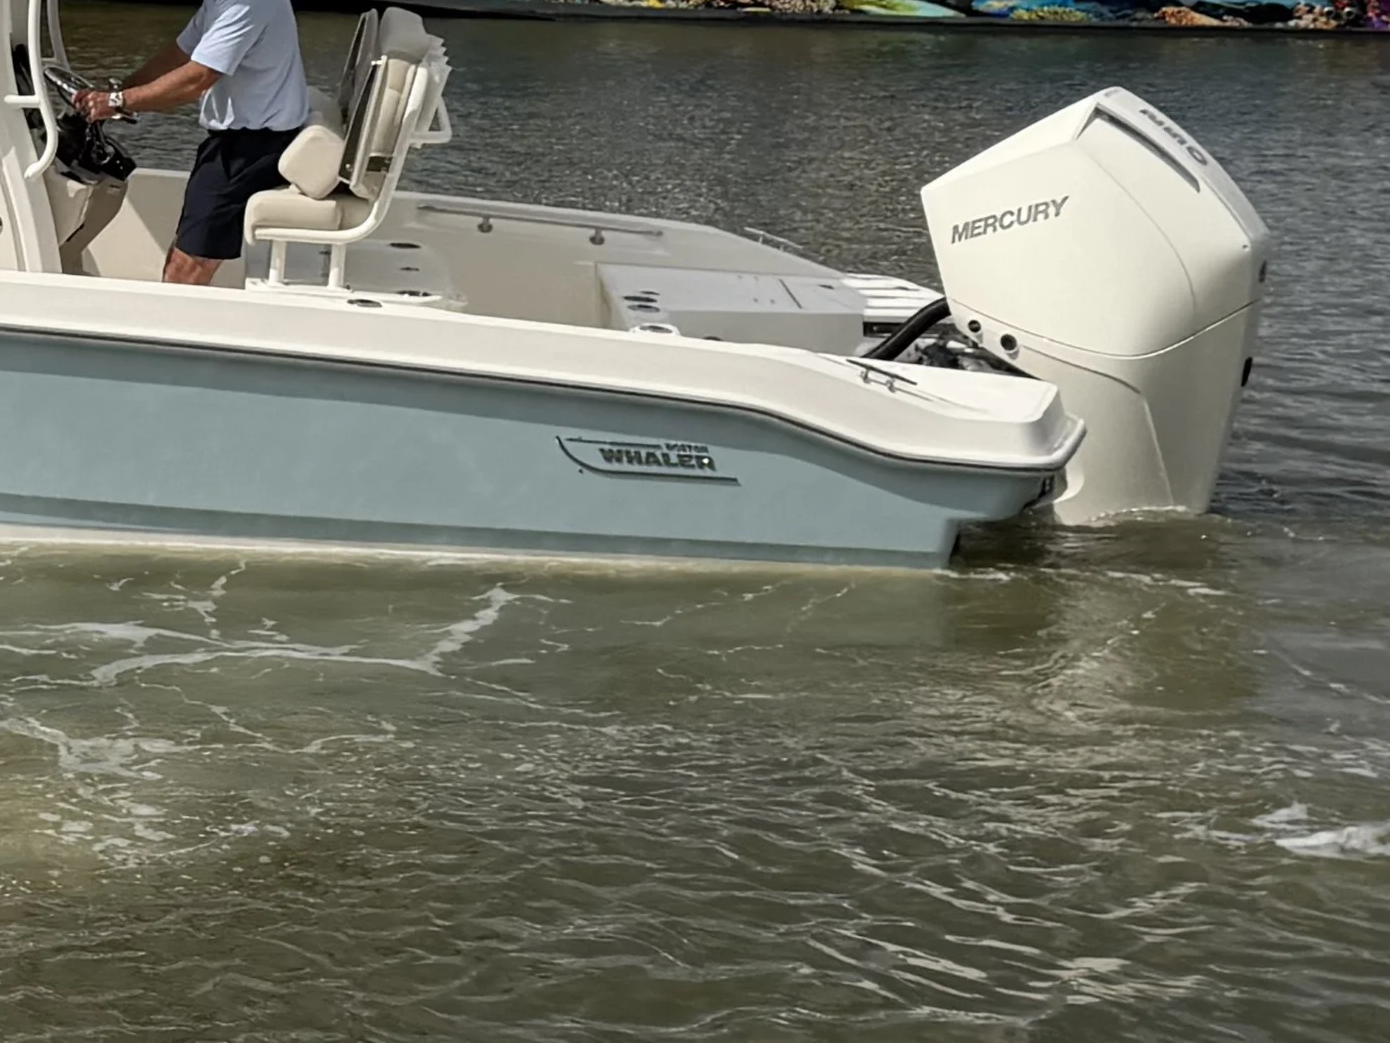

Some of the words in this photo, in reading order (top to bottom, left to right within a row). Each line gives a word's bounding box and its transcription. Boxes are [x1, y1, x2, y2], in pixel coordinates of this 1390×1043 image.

[950, 195, 1070, 244] MERCURY
[598, 447, 718, 472] WHALER
[665, 442, 710, 454] BOSTON
